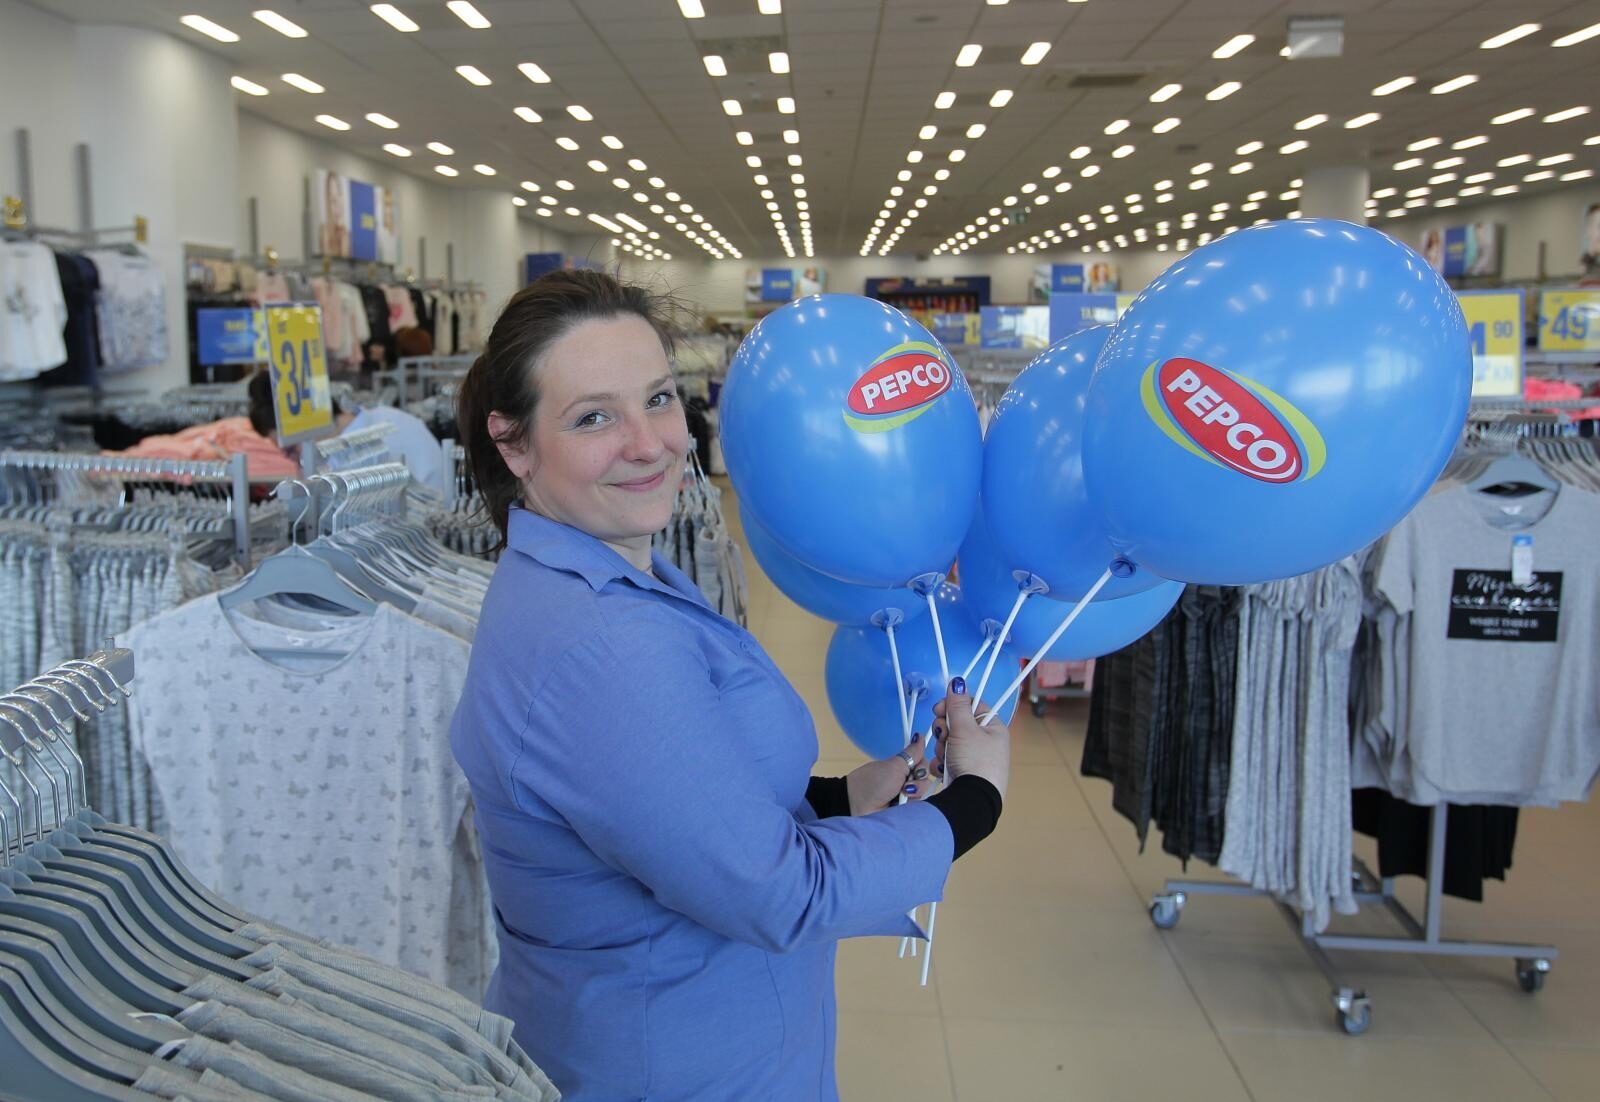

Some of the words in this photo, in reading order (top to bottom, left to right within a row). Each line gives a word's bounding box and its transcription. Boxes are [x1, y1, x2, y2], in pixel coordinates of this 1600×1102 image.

[1551, 305, 1589, 340] 49
[281, 339, 316, 416] 34
[861, 362, 944, 409] PEPCO
[1166, 369, 1286, 470] PEPCO
